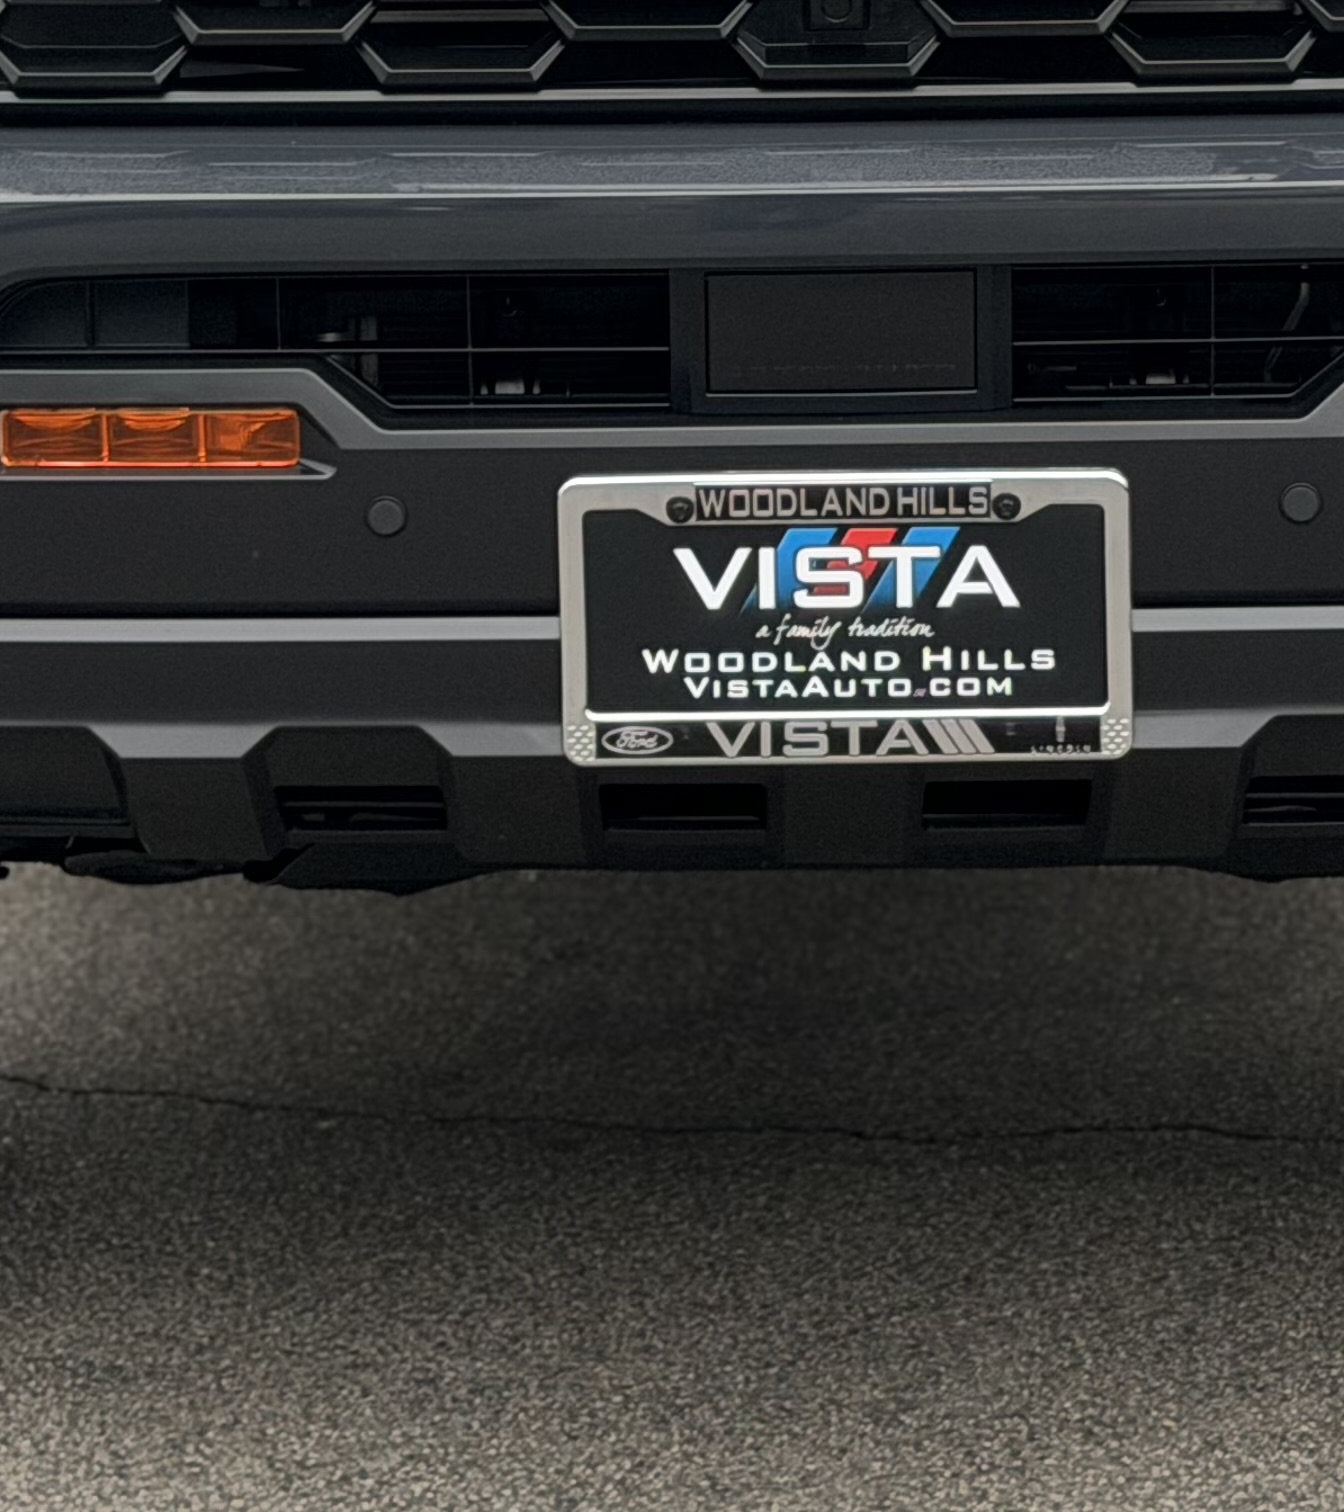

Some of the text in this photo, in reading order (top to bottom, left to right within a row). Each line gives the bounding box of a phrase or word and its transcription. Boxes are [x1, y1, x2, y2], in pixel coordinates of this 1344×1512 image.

[698, 485, 989, 518] WOODLAND HILLS
[672, 543, 1021, 610] VISTA
[755, 613, 936, 651] a family tradition
[641, 645, 1056, 675] WOODLAND HILLS
[706, 719, 930, 759] VISTA
